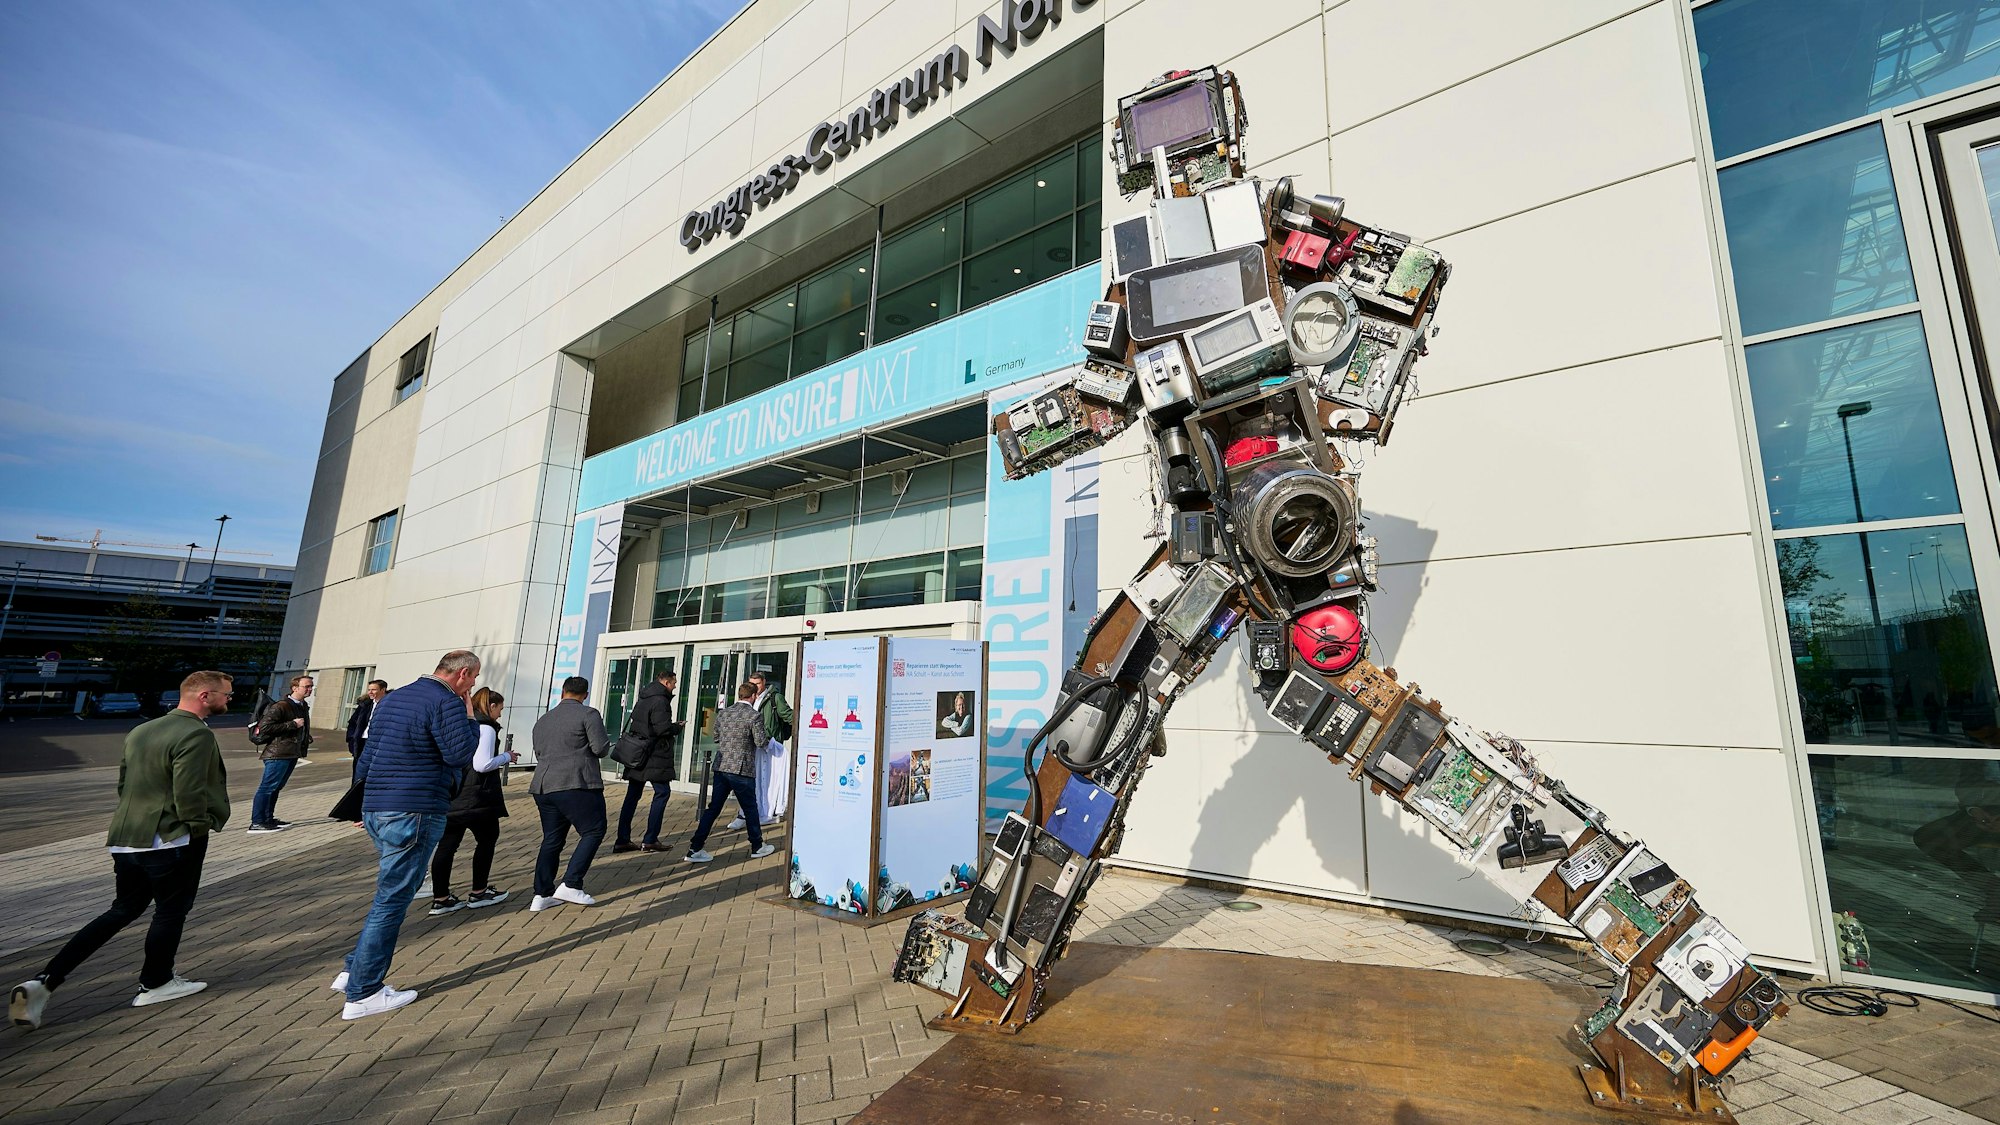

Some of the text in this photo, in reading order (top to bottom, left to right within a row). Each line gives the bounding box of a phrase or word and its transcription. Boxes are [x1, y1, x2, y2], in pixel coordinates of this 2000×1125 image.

[680, 44, 969, 250] Congress-Centrum
[634, 419, 721, 487] WELCOME
[725, 407, 750, 458] TO
[755, 373, 842, 450] INSURE
[859, 346, 918, 417] NXT
[985, 356, 1027, 376] Germany
[591, 515, 621, 585] NXT
